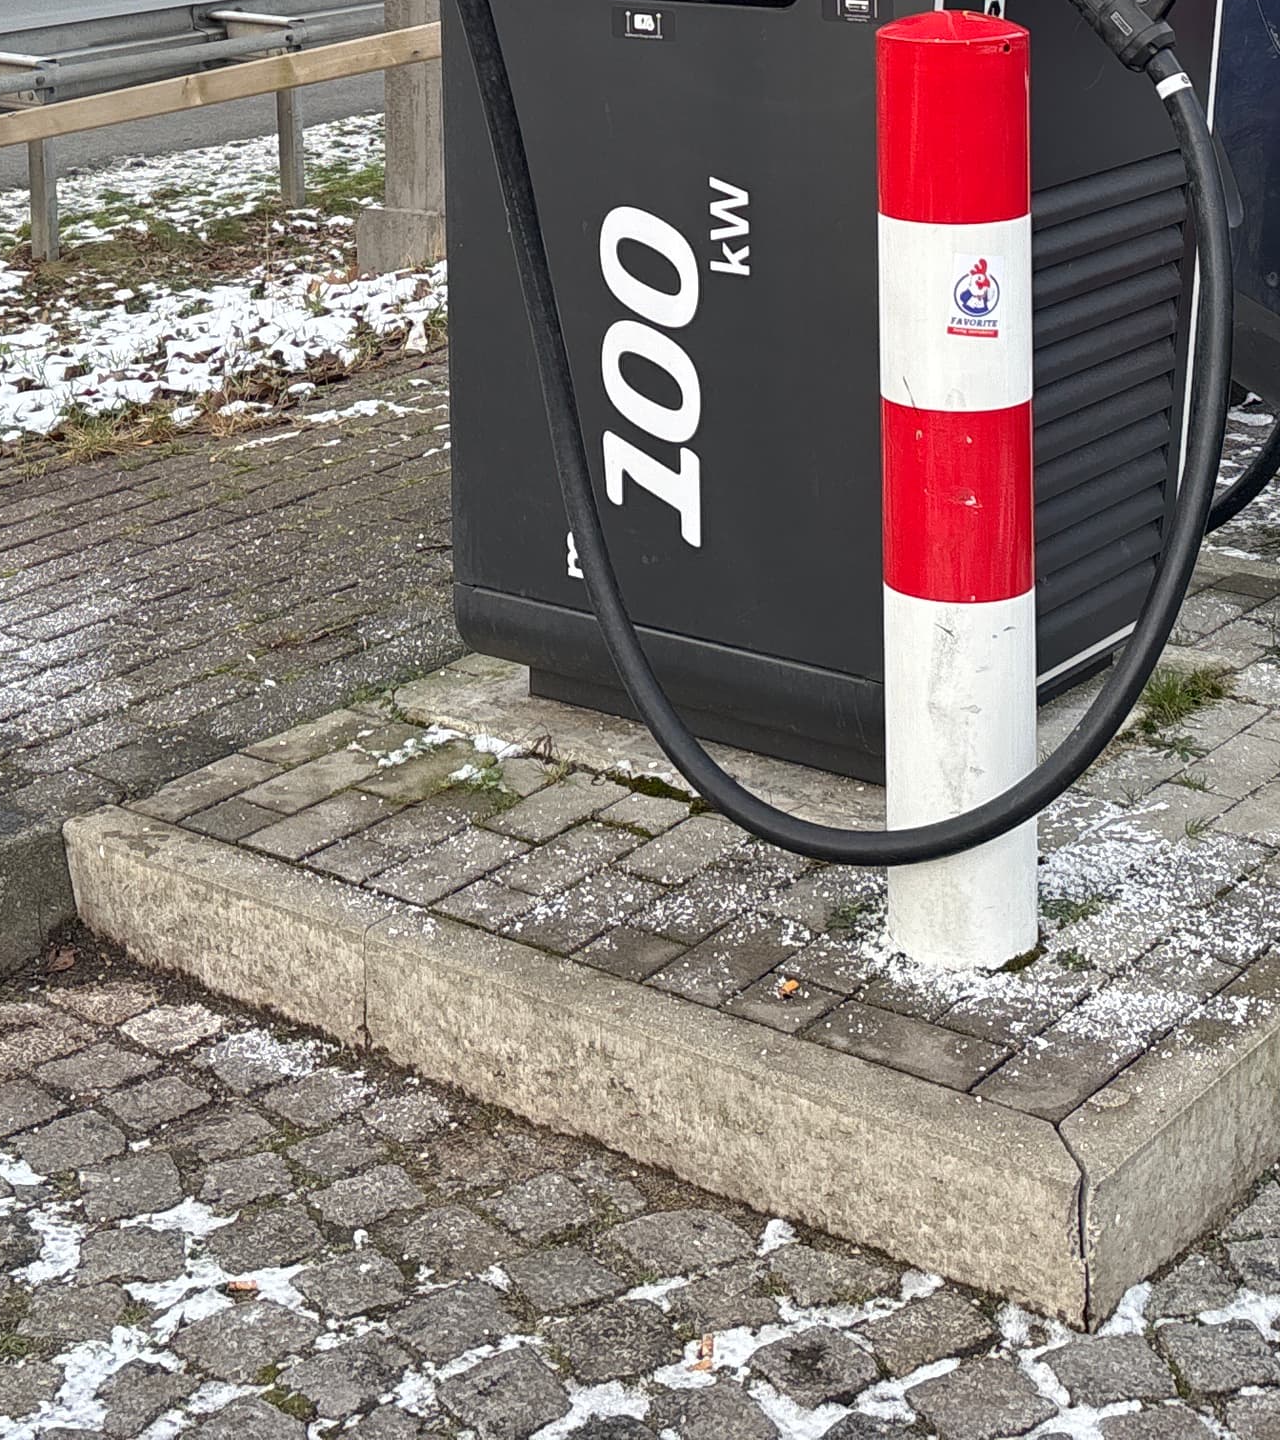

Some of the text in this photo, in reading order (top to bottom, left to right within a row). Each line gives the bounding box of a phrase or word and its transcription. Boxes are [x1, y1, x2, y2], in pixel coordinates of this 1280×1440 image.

[708, 176, 750, 276] kW
[950, 317, 998, 327] FAVORITE
[599, 206, 701, 548] 100
